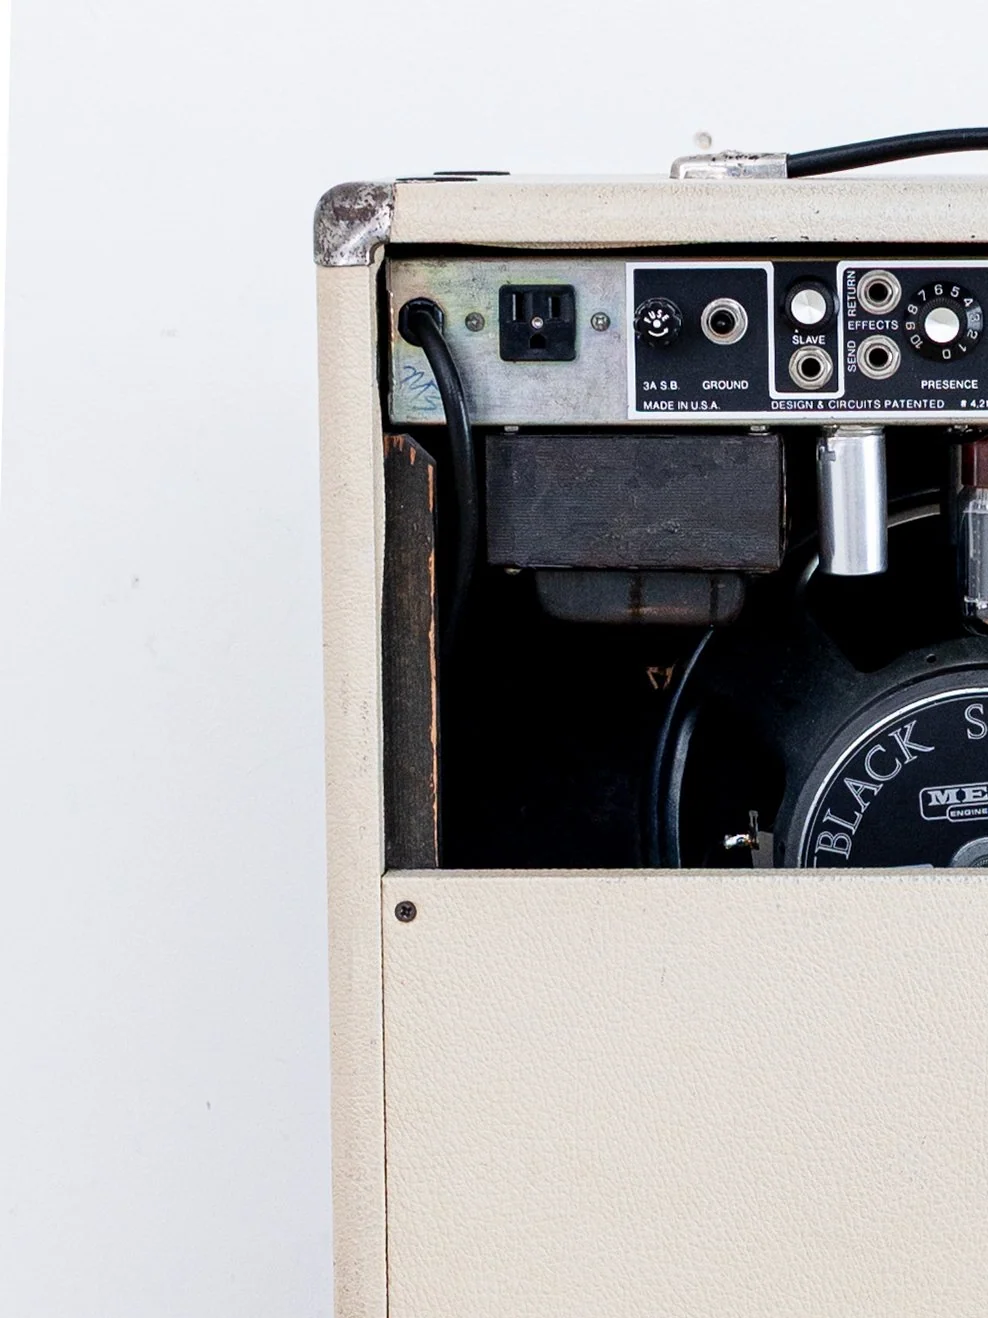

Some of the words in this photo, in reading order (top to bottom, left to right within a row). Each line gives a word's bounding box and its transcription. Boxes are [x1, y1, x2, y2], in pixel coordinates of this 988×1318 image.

[847, 270, 856, 317] RETURN
[918, 289, 928, 301] 7
[934, 284, 943, 296] 6
[950, 285, 960, 298] 5
[963, 297, 974, 307] 4
[907, 303, 918, 315] 8
[847, 320, 899, 330] EFFECTS
[792, 335, 826, 345] SLAVE
[847, 340, 856, 373] SEND
[941, 349, 951, 360] 0
[643, 381, 657, 390] 3A
[702, 380, 749, 390] GROUND
[921, 379, 978, 389] PRESENCE
[643, 401, 674, 410] MADE
[677, 401, 688, 410] IN
[691, 400, 720, 410] U.S.A.
[771, 400, 813, 410] DESIGN
[817, 400, 823, 409] &
[828, 399, 881, 409] CIRCUITS
[884, 399, 945, 409] PATENTED
[815, 719, 935, 860] BLACK
